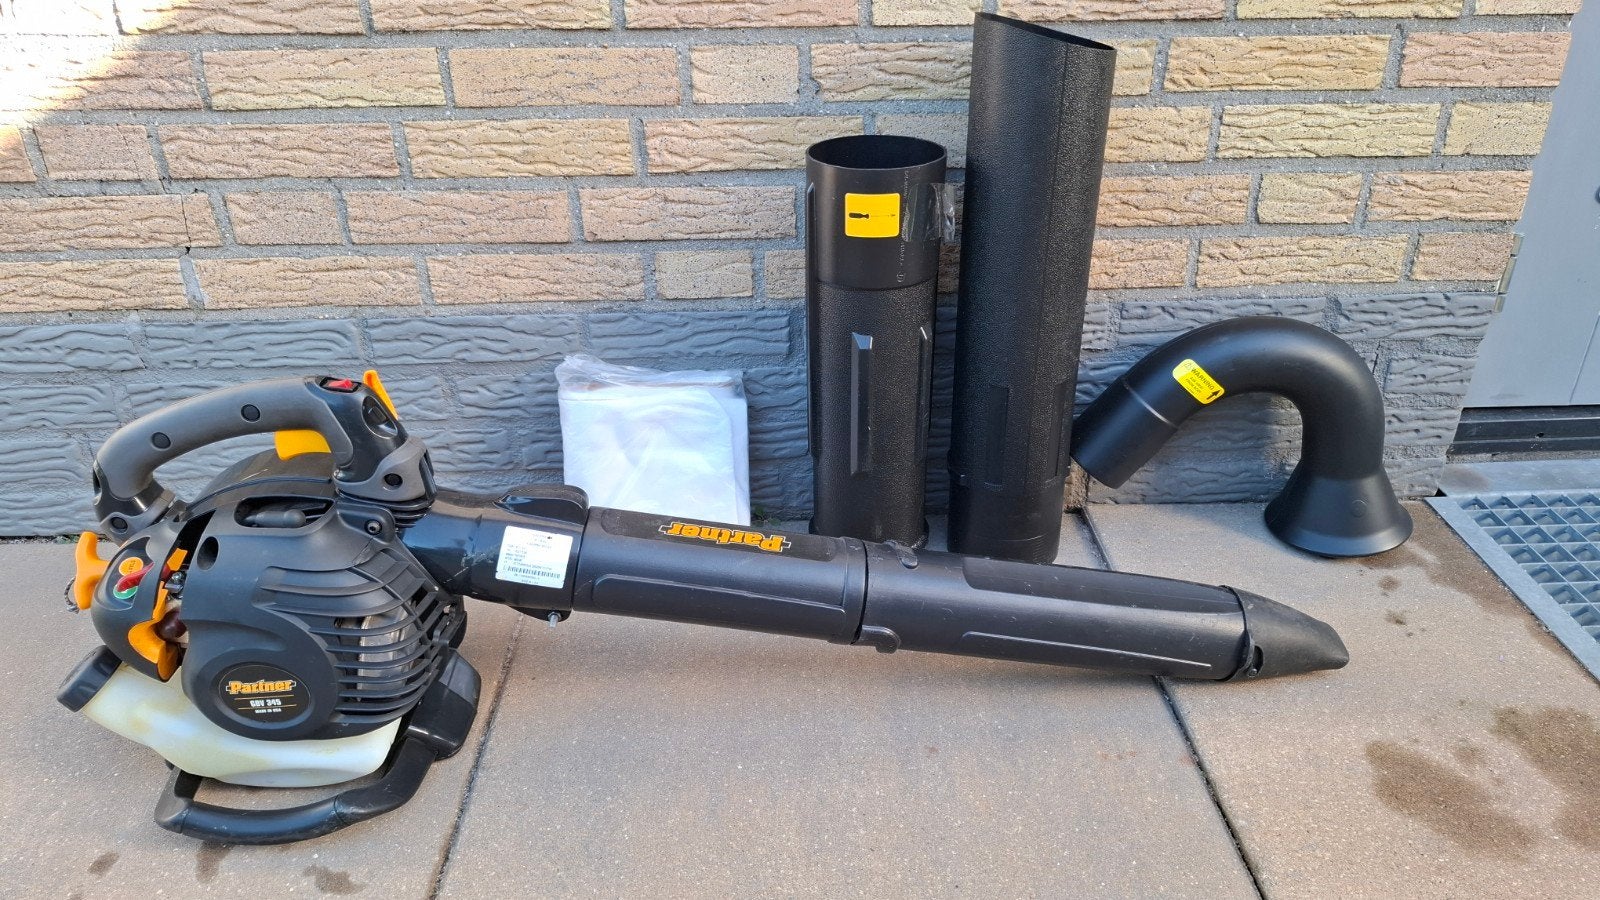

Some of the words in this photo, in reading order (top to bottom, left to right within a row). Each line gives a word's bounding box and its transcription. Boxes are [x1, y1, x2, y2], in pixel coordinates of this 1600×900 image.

[1191, 368, 1215, 391] WARNING
[661, 522, 789, 552] Partner
[228, 679, 295, 695] Partner
